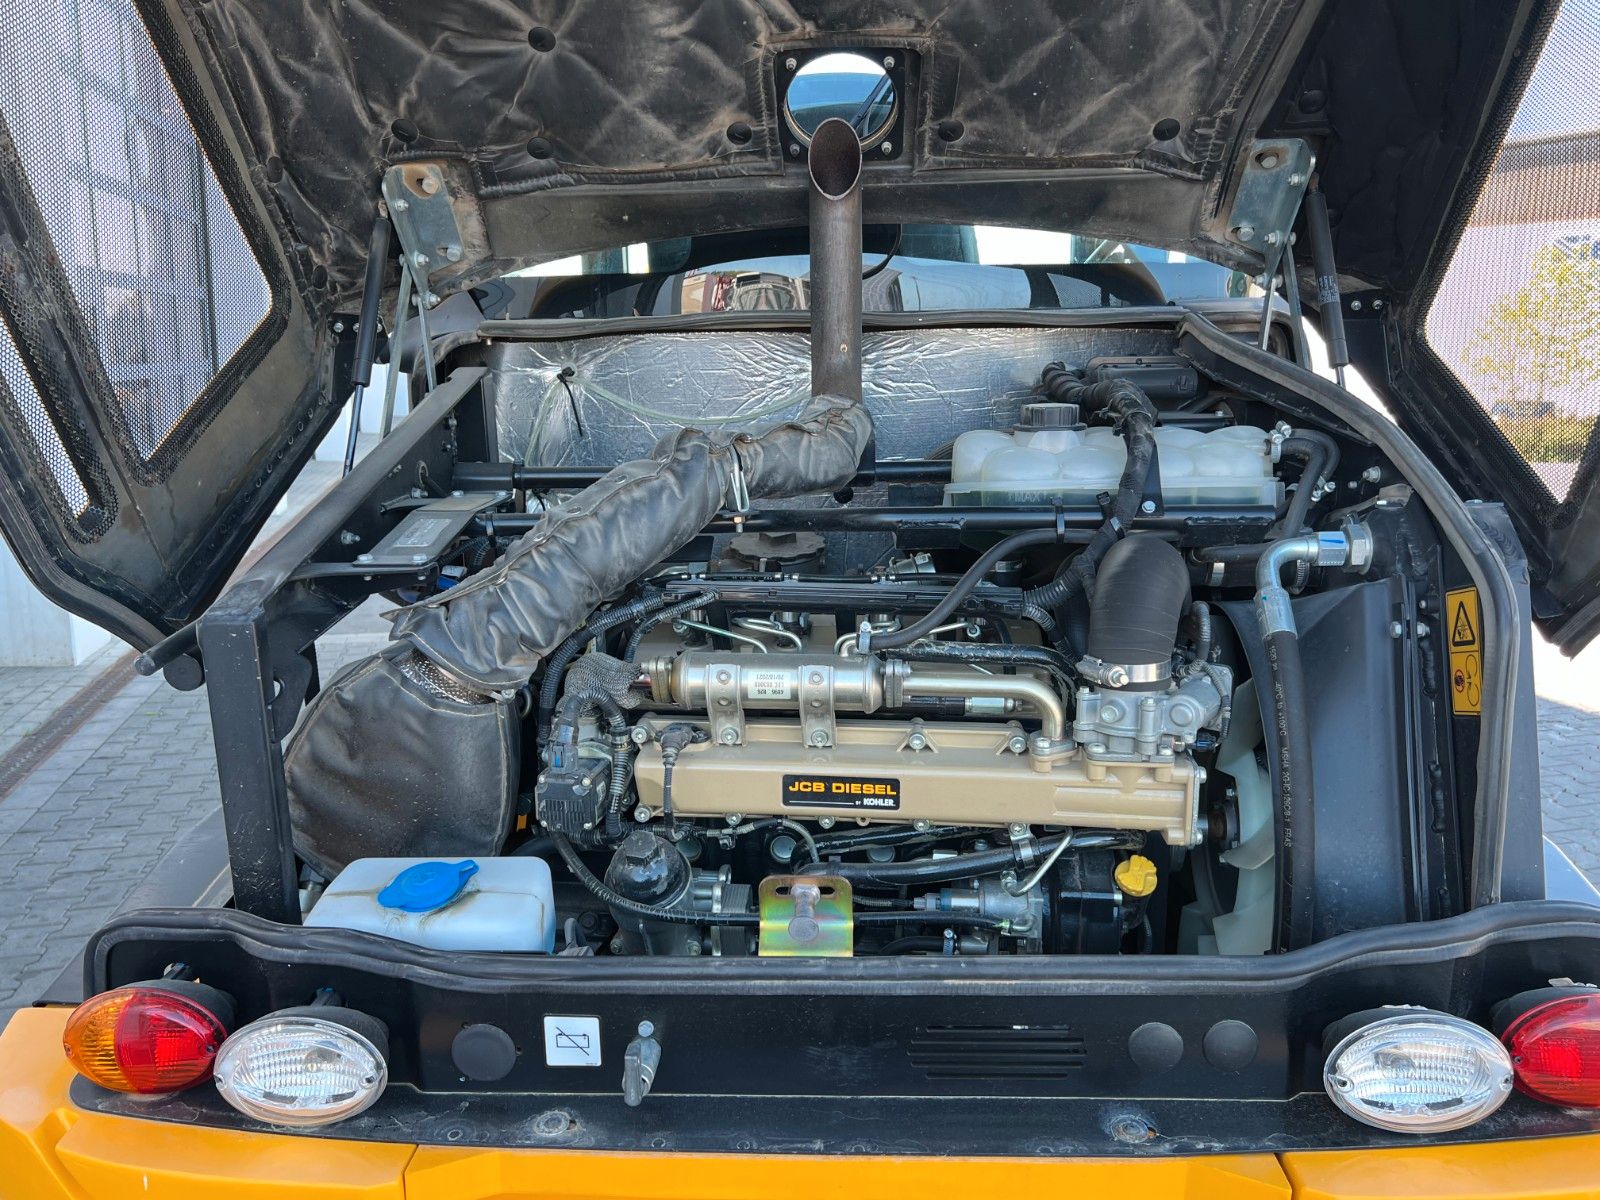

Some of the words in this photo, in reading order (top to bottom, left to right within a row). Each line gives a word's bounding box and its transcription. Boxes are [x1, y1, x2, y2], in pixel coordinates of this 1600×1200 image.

[1281, 746, 1290, 769] MSHA
[788, 781, 825, 793] JCB
[831, 782, 897, 796] DIESEL
[1284, 827, 1292, 848] FRAS
